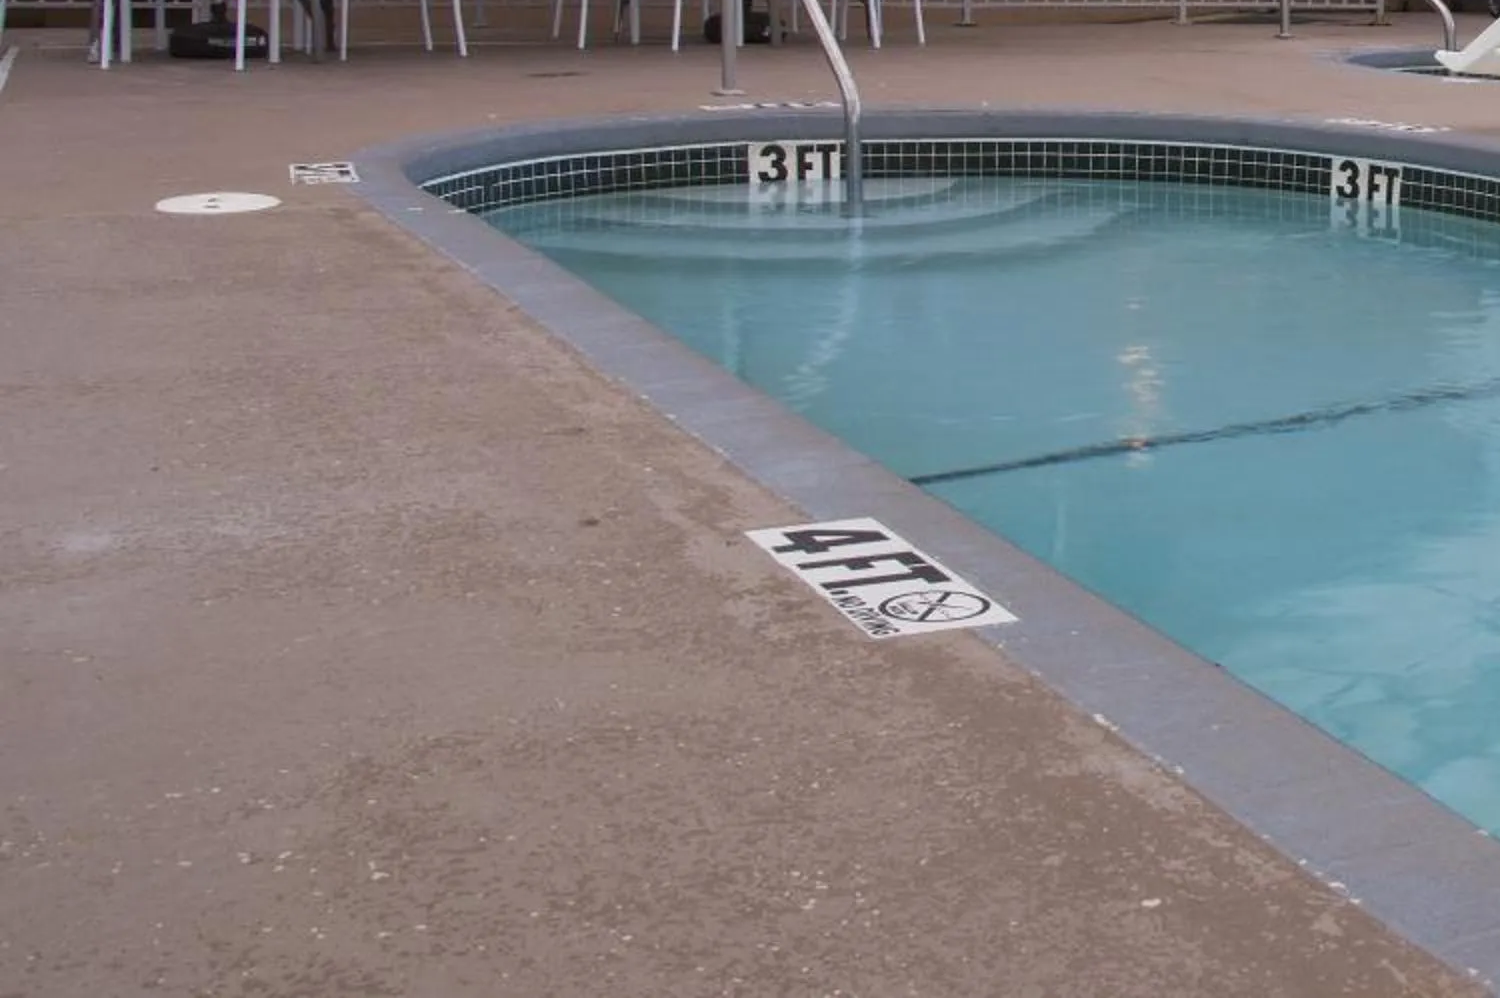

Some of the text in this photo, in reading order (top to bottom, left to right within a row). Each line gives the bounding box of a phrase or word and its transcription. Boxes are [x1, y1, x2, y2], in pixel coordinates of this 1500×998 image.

[758, 144, 837, 182] 3 FT
[1336, 159, 1400, 204] 3 FT
[772, 529, 891, 554] 4
